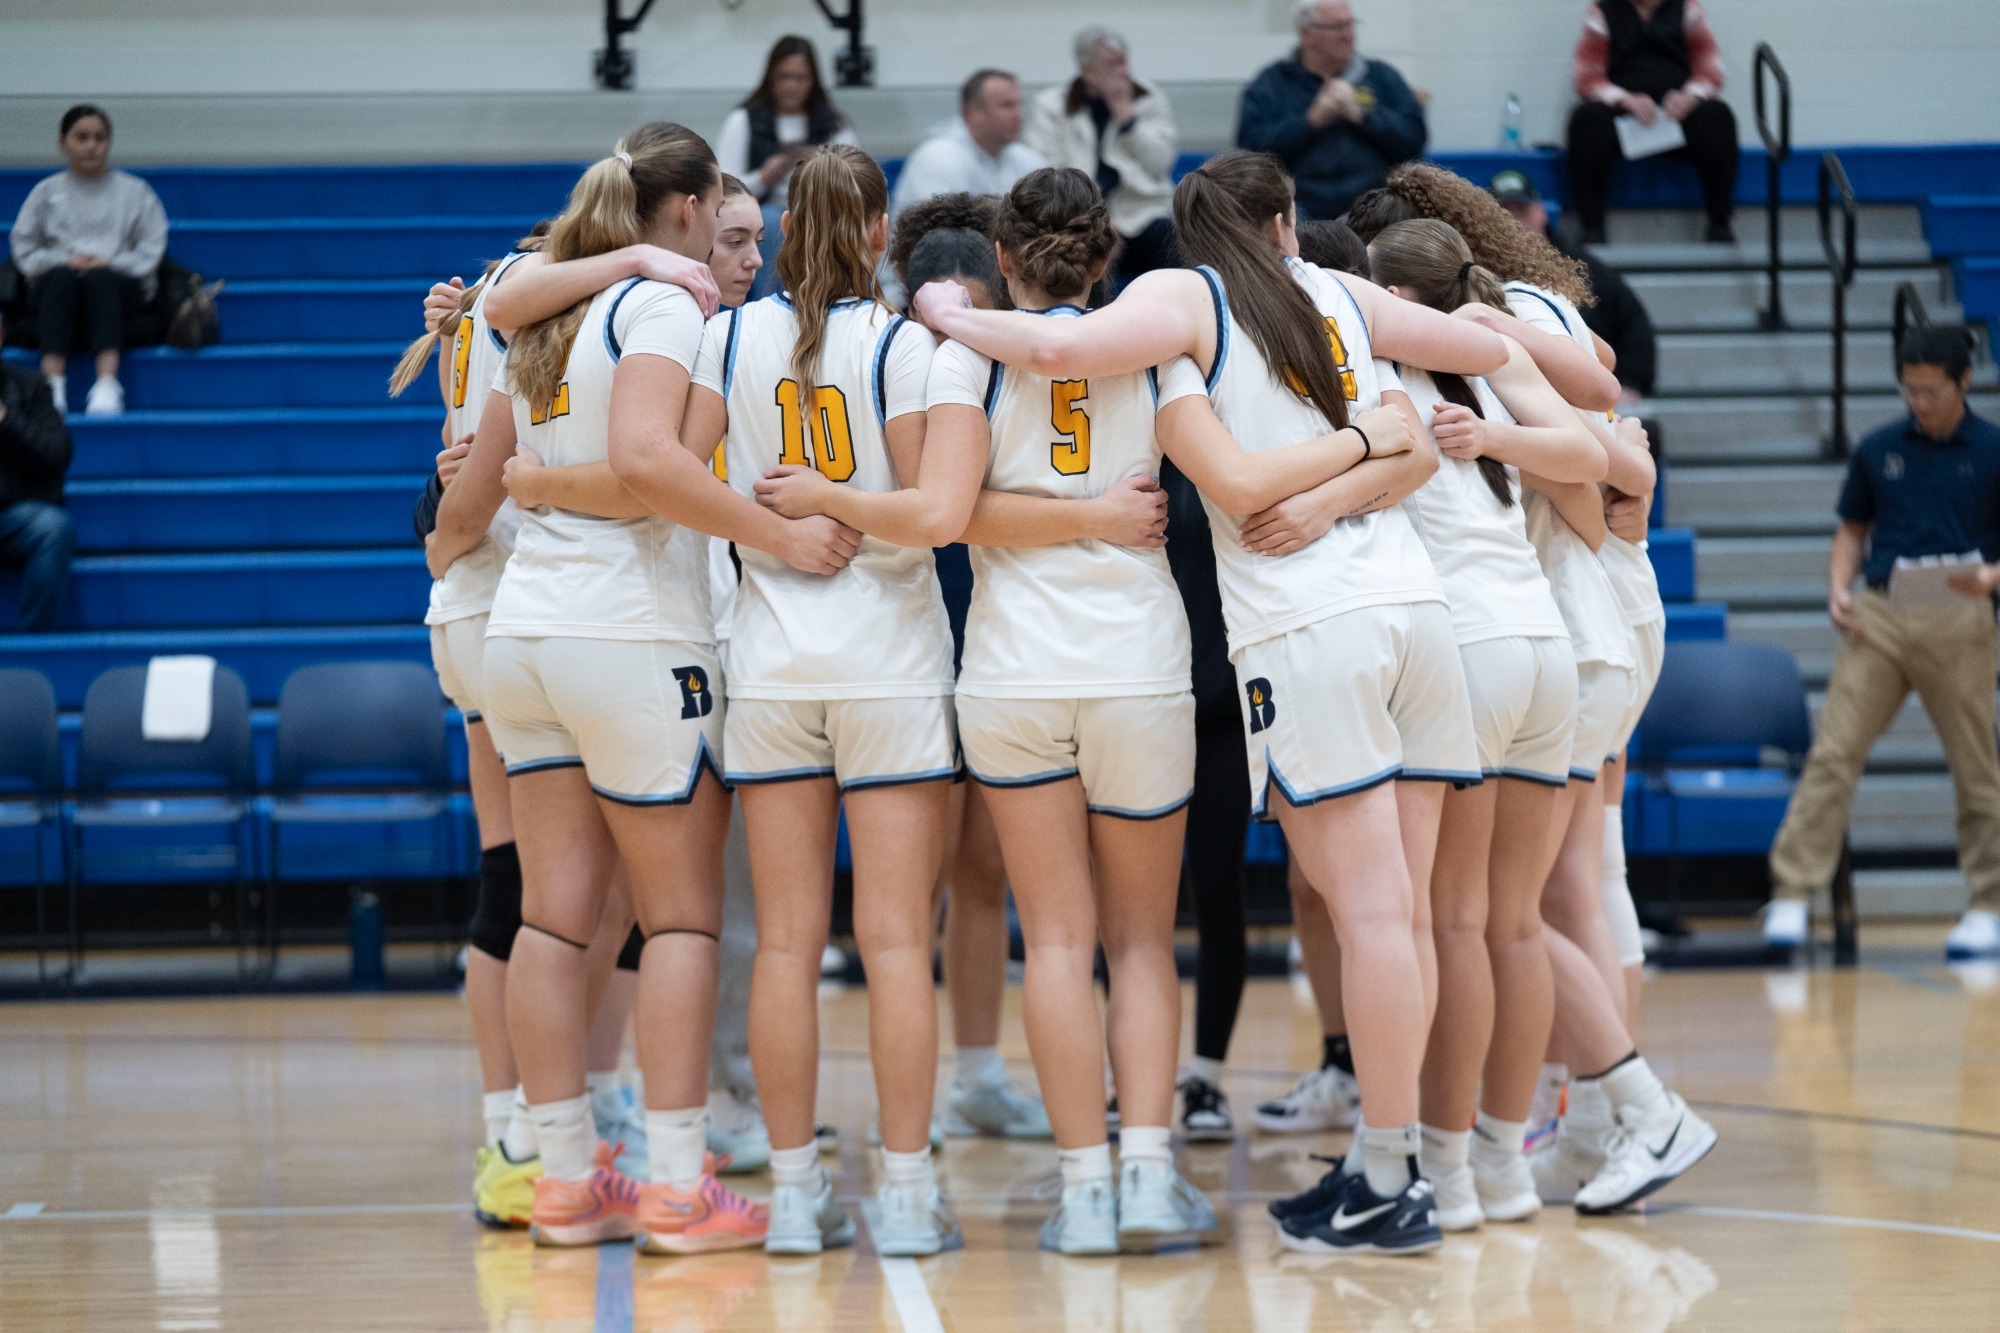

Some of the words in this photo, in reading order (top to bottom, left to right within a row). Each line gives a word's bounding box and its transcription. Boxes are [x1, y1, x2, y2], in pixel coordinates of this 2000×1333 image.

[775, 377, 857, 483] 10
[1051, 378, 1090, 475] 5
[671, 665, 713, 720] B
[1245, 677, 1276, 735] B
